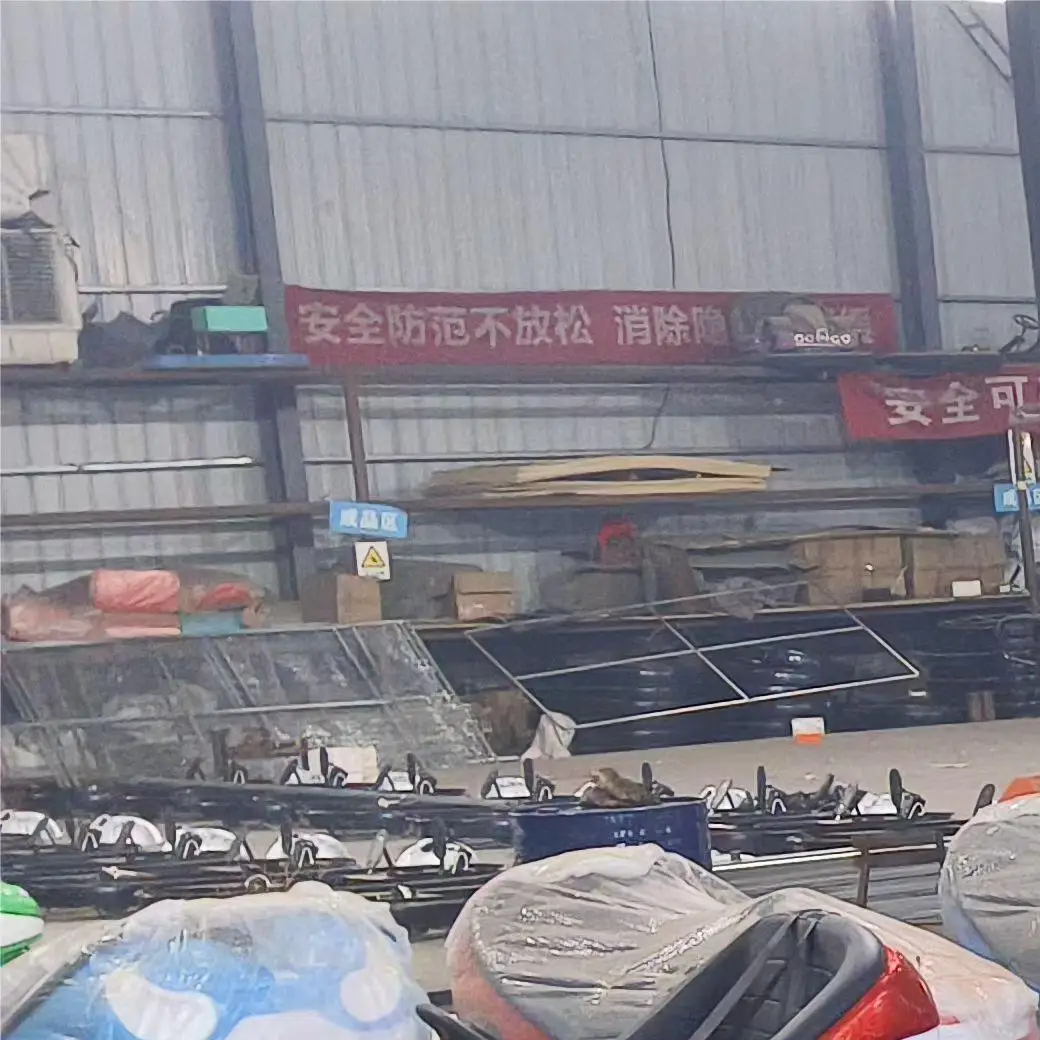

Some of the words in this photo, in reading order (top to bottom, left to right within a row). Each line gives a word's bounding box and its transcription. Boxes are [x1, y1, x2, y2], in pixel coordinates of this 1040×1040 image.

[298, 303, 594, 349] 安全防范不放松
